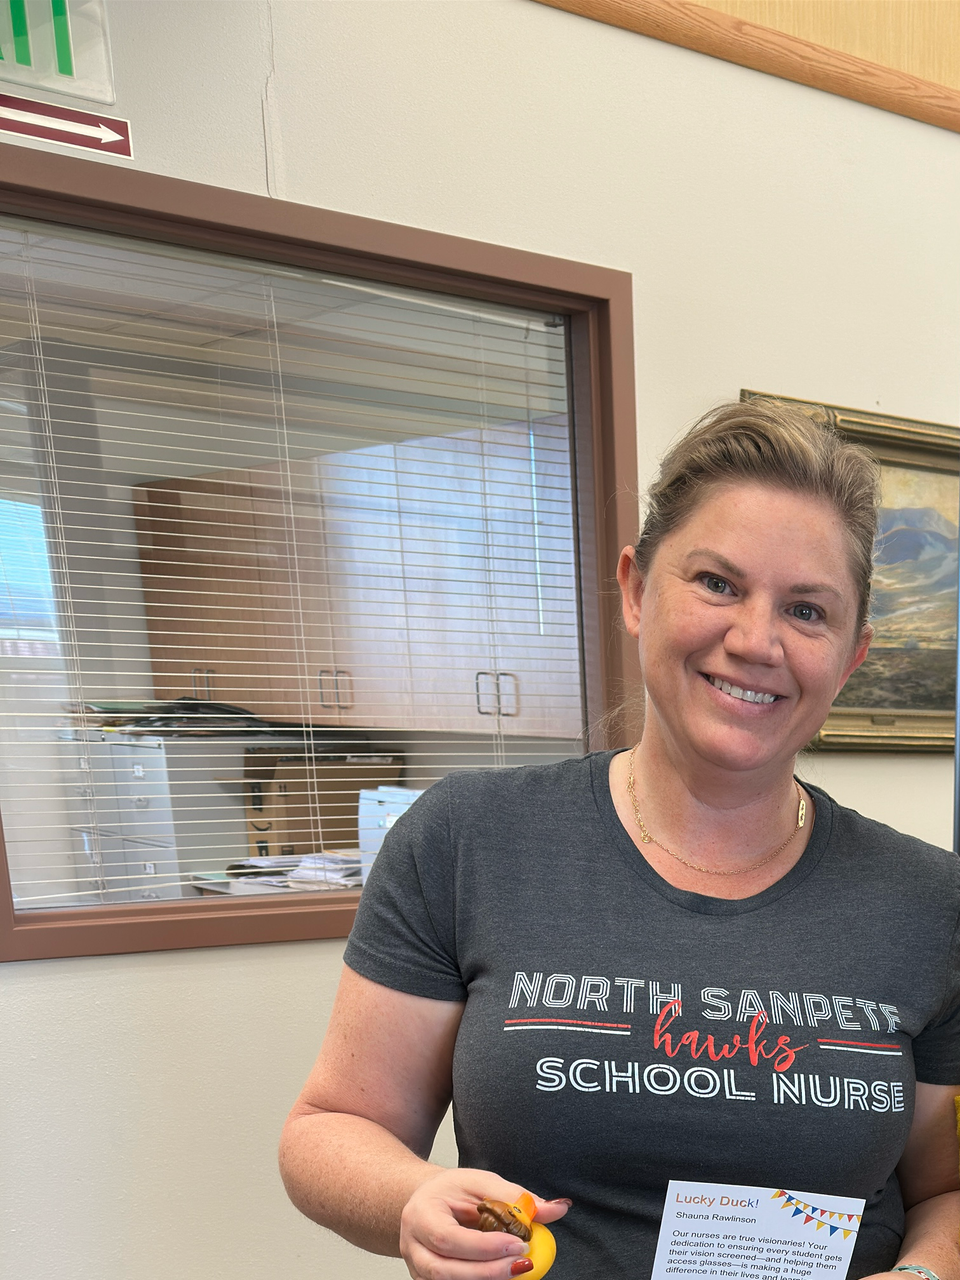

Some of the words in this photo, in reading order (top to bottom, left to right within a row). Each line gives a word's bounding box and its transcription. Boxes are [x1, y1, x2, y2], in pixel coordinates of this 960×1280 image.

[508, 971, 682, 1016] NORTH
[653, 1000, 809, 1072] hawks
[535, 1056, 757, 1101] SCHOOL
[772, 1072, 905, 1113] NURSE
[675, 1193, 716, 1208] Lucky
[720, 1196, 759, 1209] Duck!
[675, 1211, 710, 1221] Shauna
[712, 1213, 757, 1224] Rawlinson
[670, 1239, 715, 1249] dedication
[727, 1243, 764, 1254] ensuring
[766, 1247, 790, 1257] every
[791, 1250, 823, 1260] student
[824, 1254, 843, 1263] gets
[672, 1229, 689, 1238] Our
[691, 1232, 720, 1240] nurses
[739, 1234, 756, 1243] true
[758, 1236, 806, 1248] visionaries!
[808, 1241, 828, 1251] Your
[669, 1248, 688, 1256] their
[690, 1249, 715, 1258] vision
[783, 1258, 814, 1269] helping
[816, 1261, 837, 1271] them
[750, 1264, 781, 1274] making
[791, 1267, 812, 1277] huge
[665, 1266, 708, 1275] difference
[709, 1268, 718, 1276] in
[720, 1269, 739, 1278] their
[740, 1271, 760, 1280] lives
